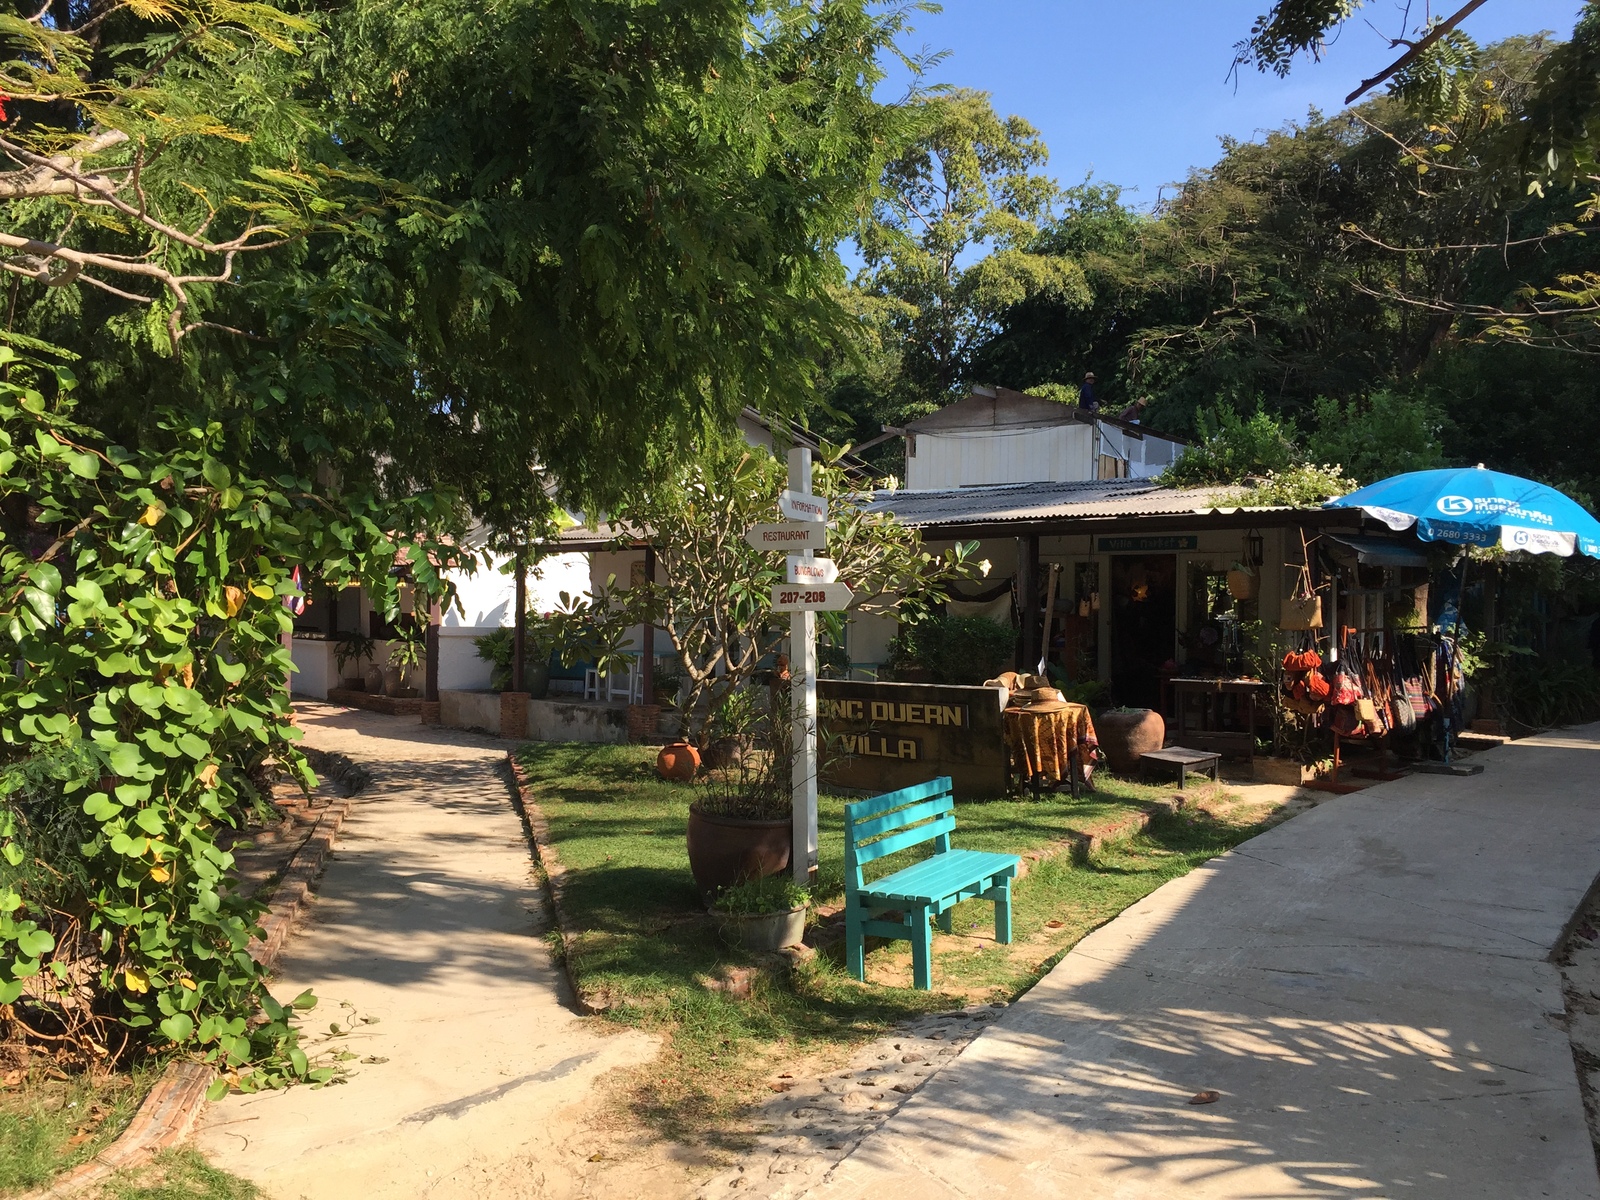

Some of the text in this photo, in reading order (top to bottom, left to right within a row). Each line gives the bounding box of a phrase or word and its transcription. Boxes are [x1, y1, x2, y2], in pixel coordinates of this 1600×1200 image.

[790, 499, 823, 516] INFORMATION
[762, 530, 810, 542] RESTAURANT
[1436, 528, 1461, 540] 2680
[1462, 531, 1488, 543] 3333
[1109, 539, 1132, 549] Villa
[794, 564, 825, 578] BUNGALOWS
[779, 590, 826, 604] 207-208
[870, 701, 962, 727] DUERN
[841, 733, 917, 760] VILLA
